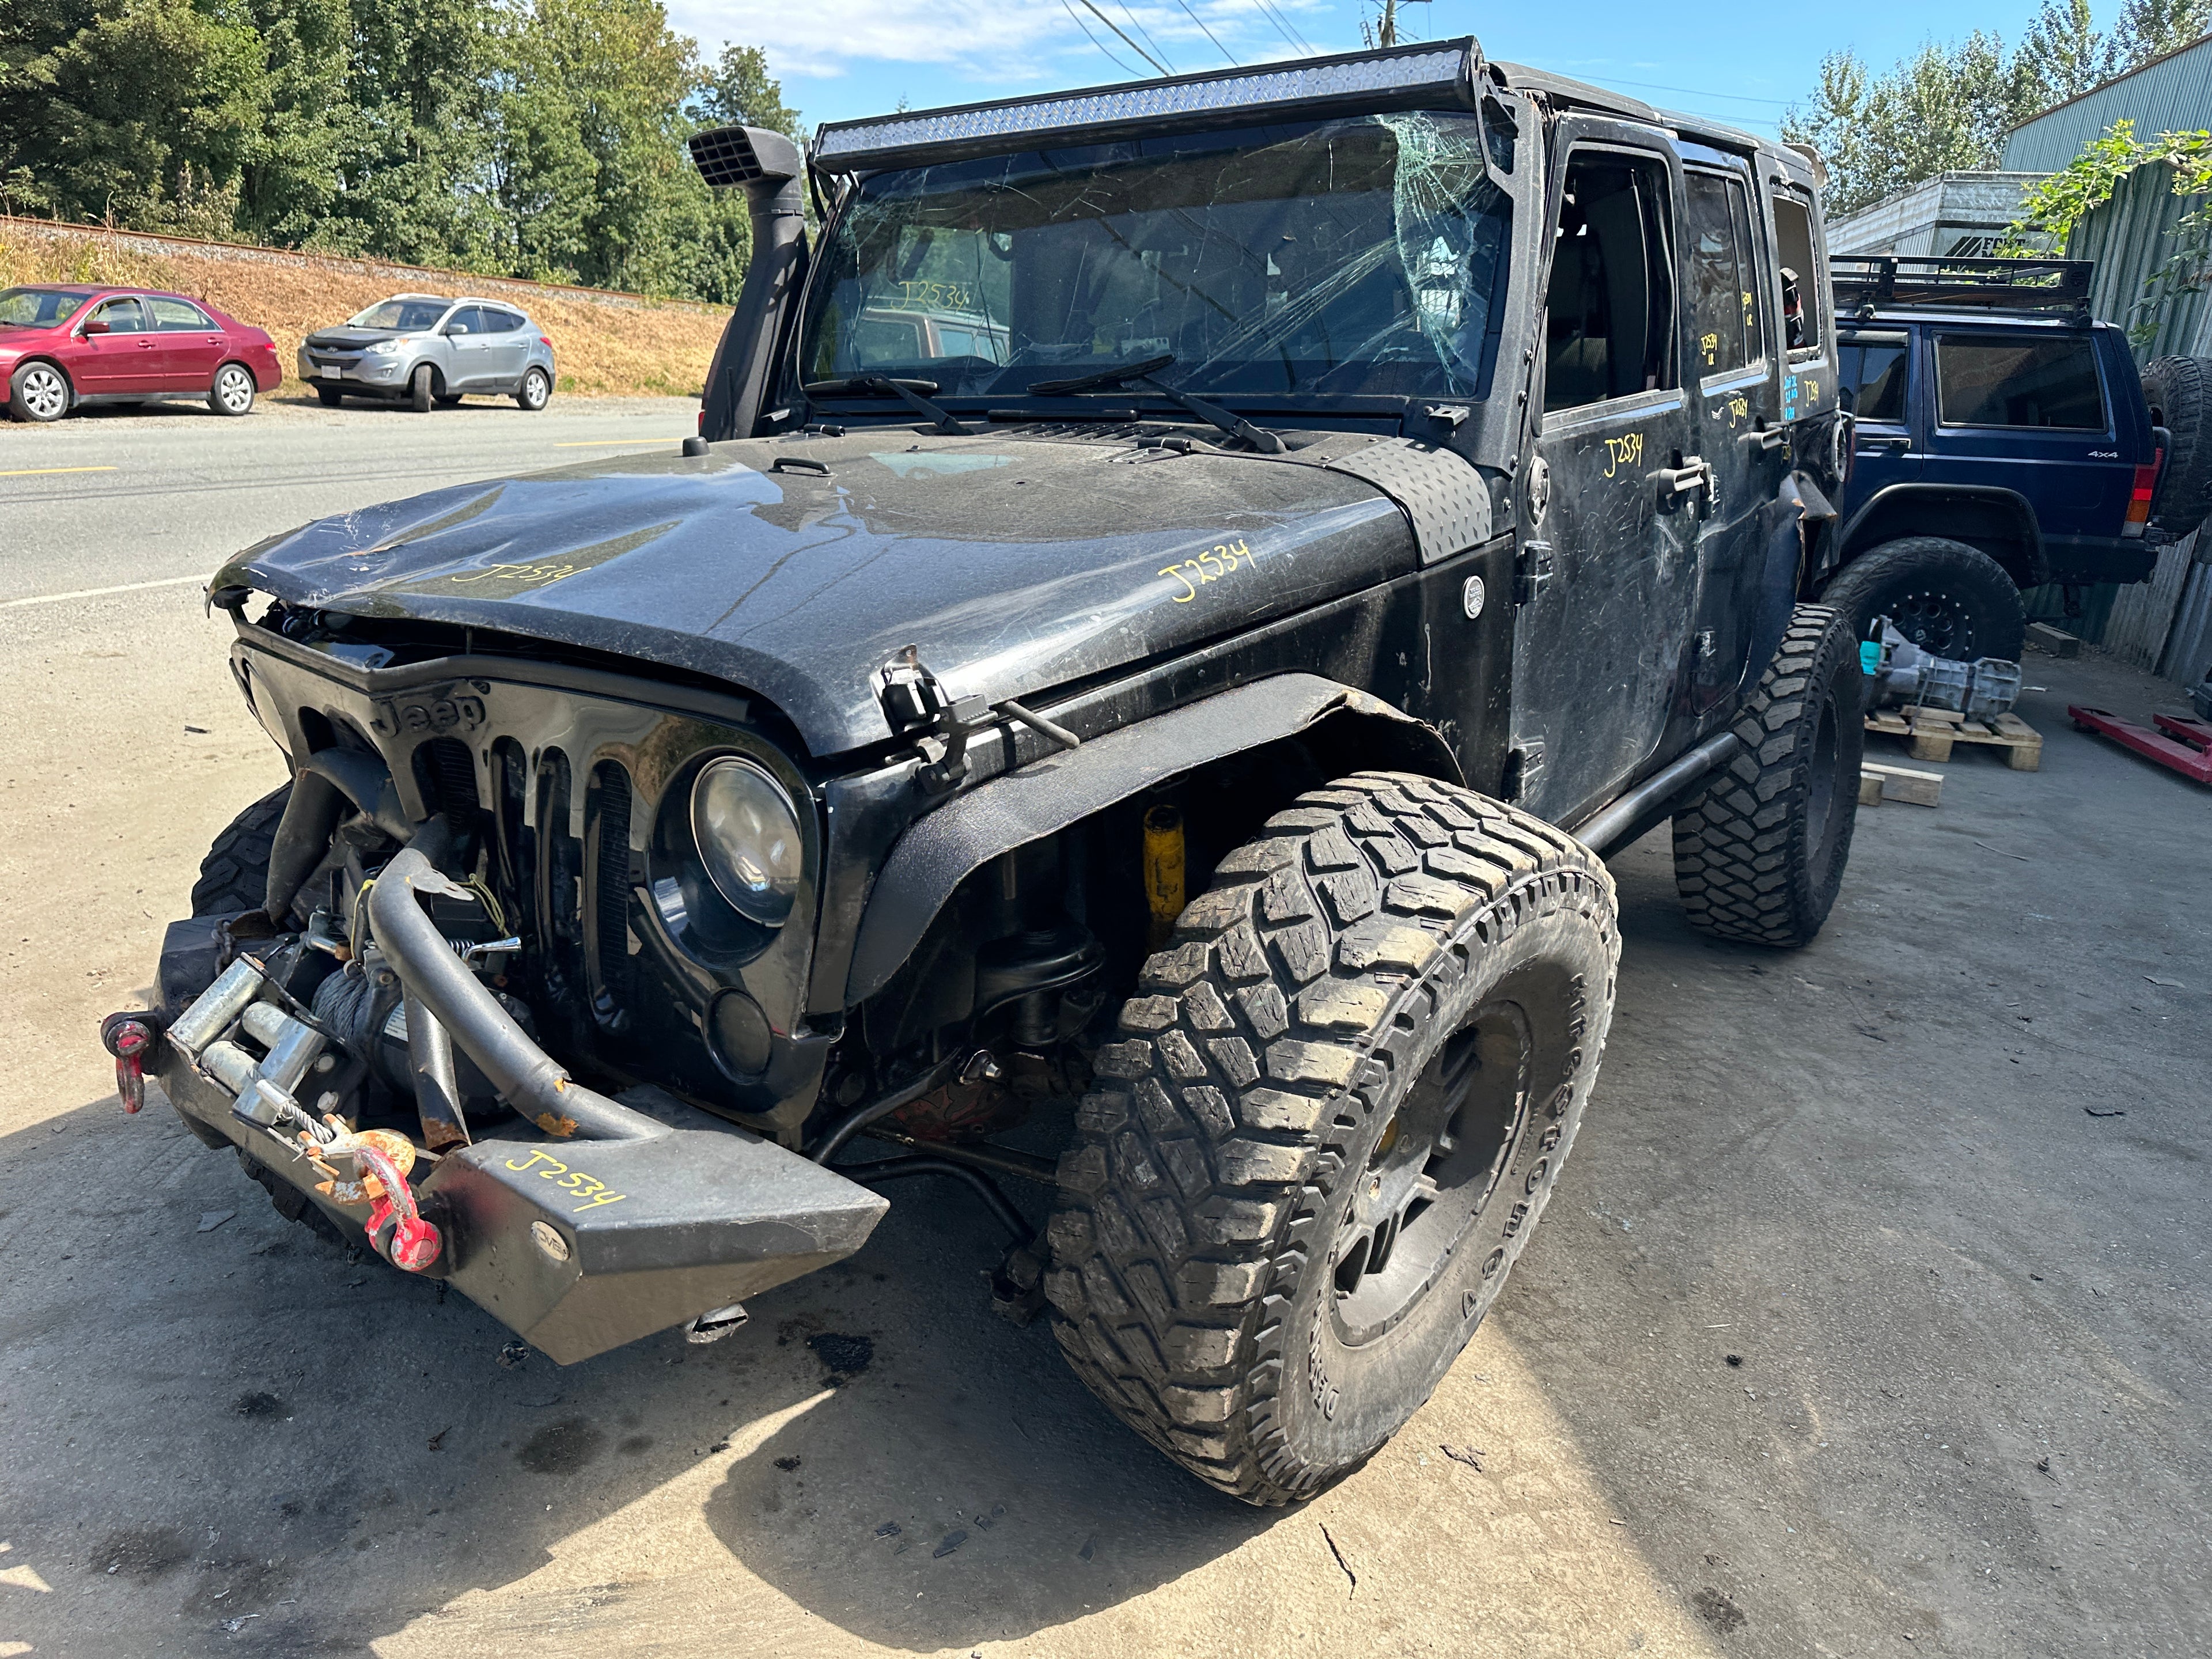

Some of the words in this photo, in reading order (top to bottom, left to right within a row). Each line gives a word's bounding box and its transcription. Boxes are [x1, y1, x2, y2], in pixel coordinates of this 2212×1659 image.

[891, 281, 969, 315] J2534
[1728, 397, 1749, 429] J2534
[1604, 433, 1643, 478] J2534
[452, 563, 592, 587] J2534
[1157, 539, 1256, 604] J2534
[369, 695, 486, 738] Jeep
[505, 1149, 627, 1213] J2534
